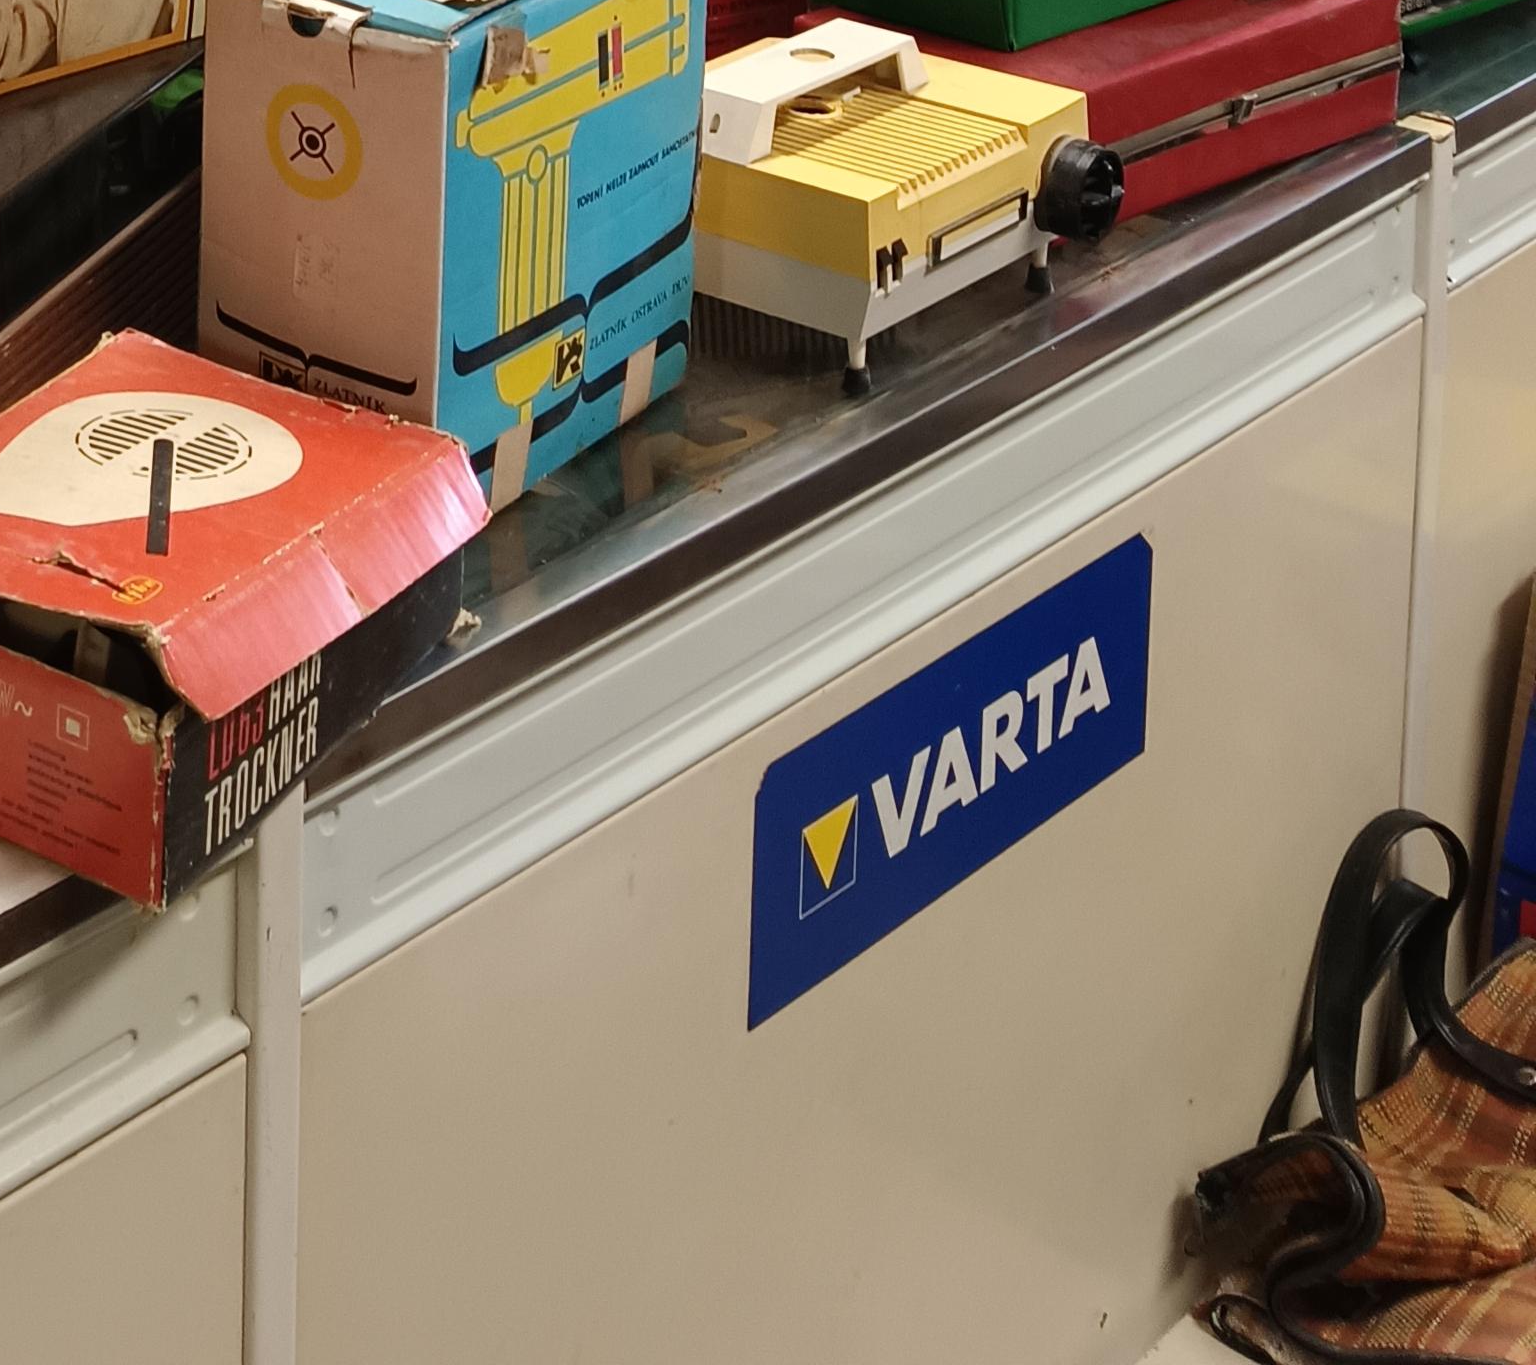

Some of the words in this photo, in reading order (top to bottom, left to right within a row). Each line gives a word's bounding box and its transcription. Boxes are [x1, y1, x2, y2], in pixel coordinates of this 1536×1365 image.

[588, 317, 628, 351] ZLATNÍK
[630, 294, 669, 324] OSTRAVA
[313, 378, 386, 414] ZLATNÍK
[203, 696, 320, 857] TROCKNER
[871, 636, 1111, 859] VARTA
